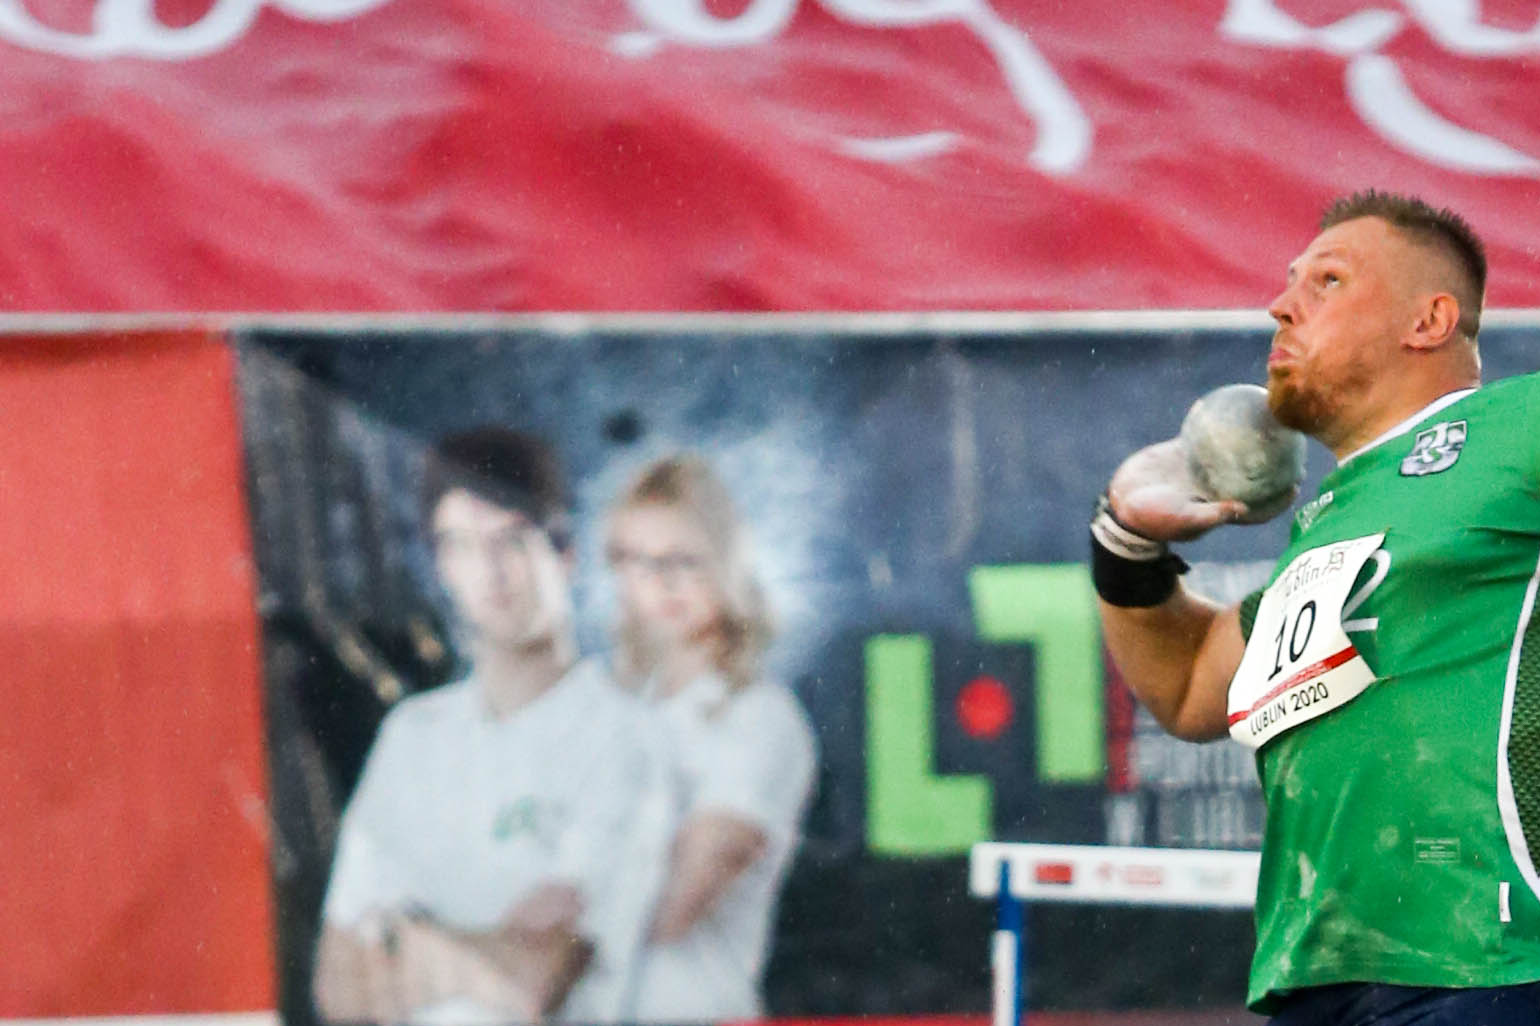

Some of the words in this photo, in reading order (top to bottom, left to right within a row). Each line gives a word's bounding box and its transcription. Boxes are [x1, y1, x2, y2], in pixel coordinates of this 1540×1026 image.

[1267, 600, 1317, 682] 10
[1250, 702, 1287, 736] LUBLIN
[1289, 682, 1329, 712] 2020
